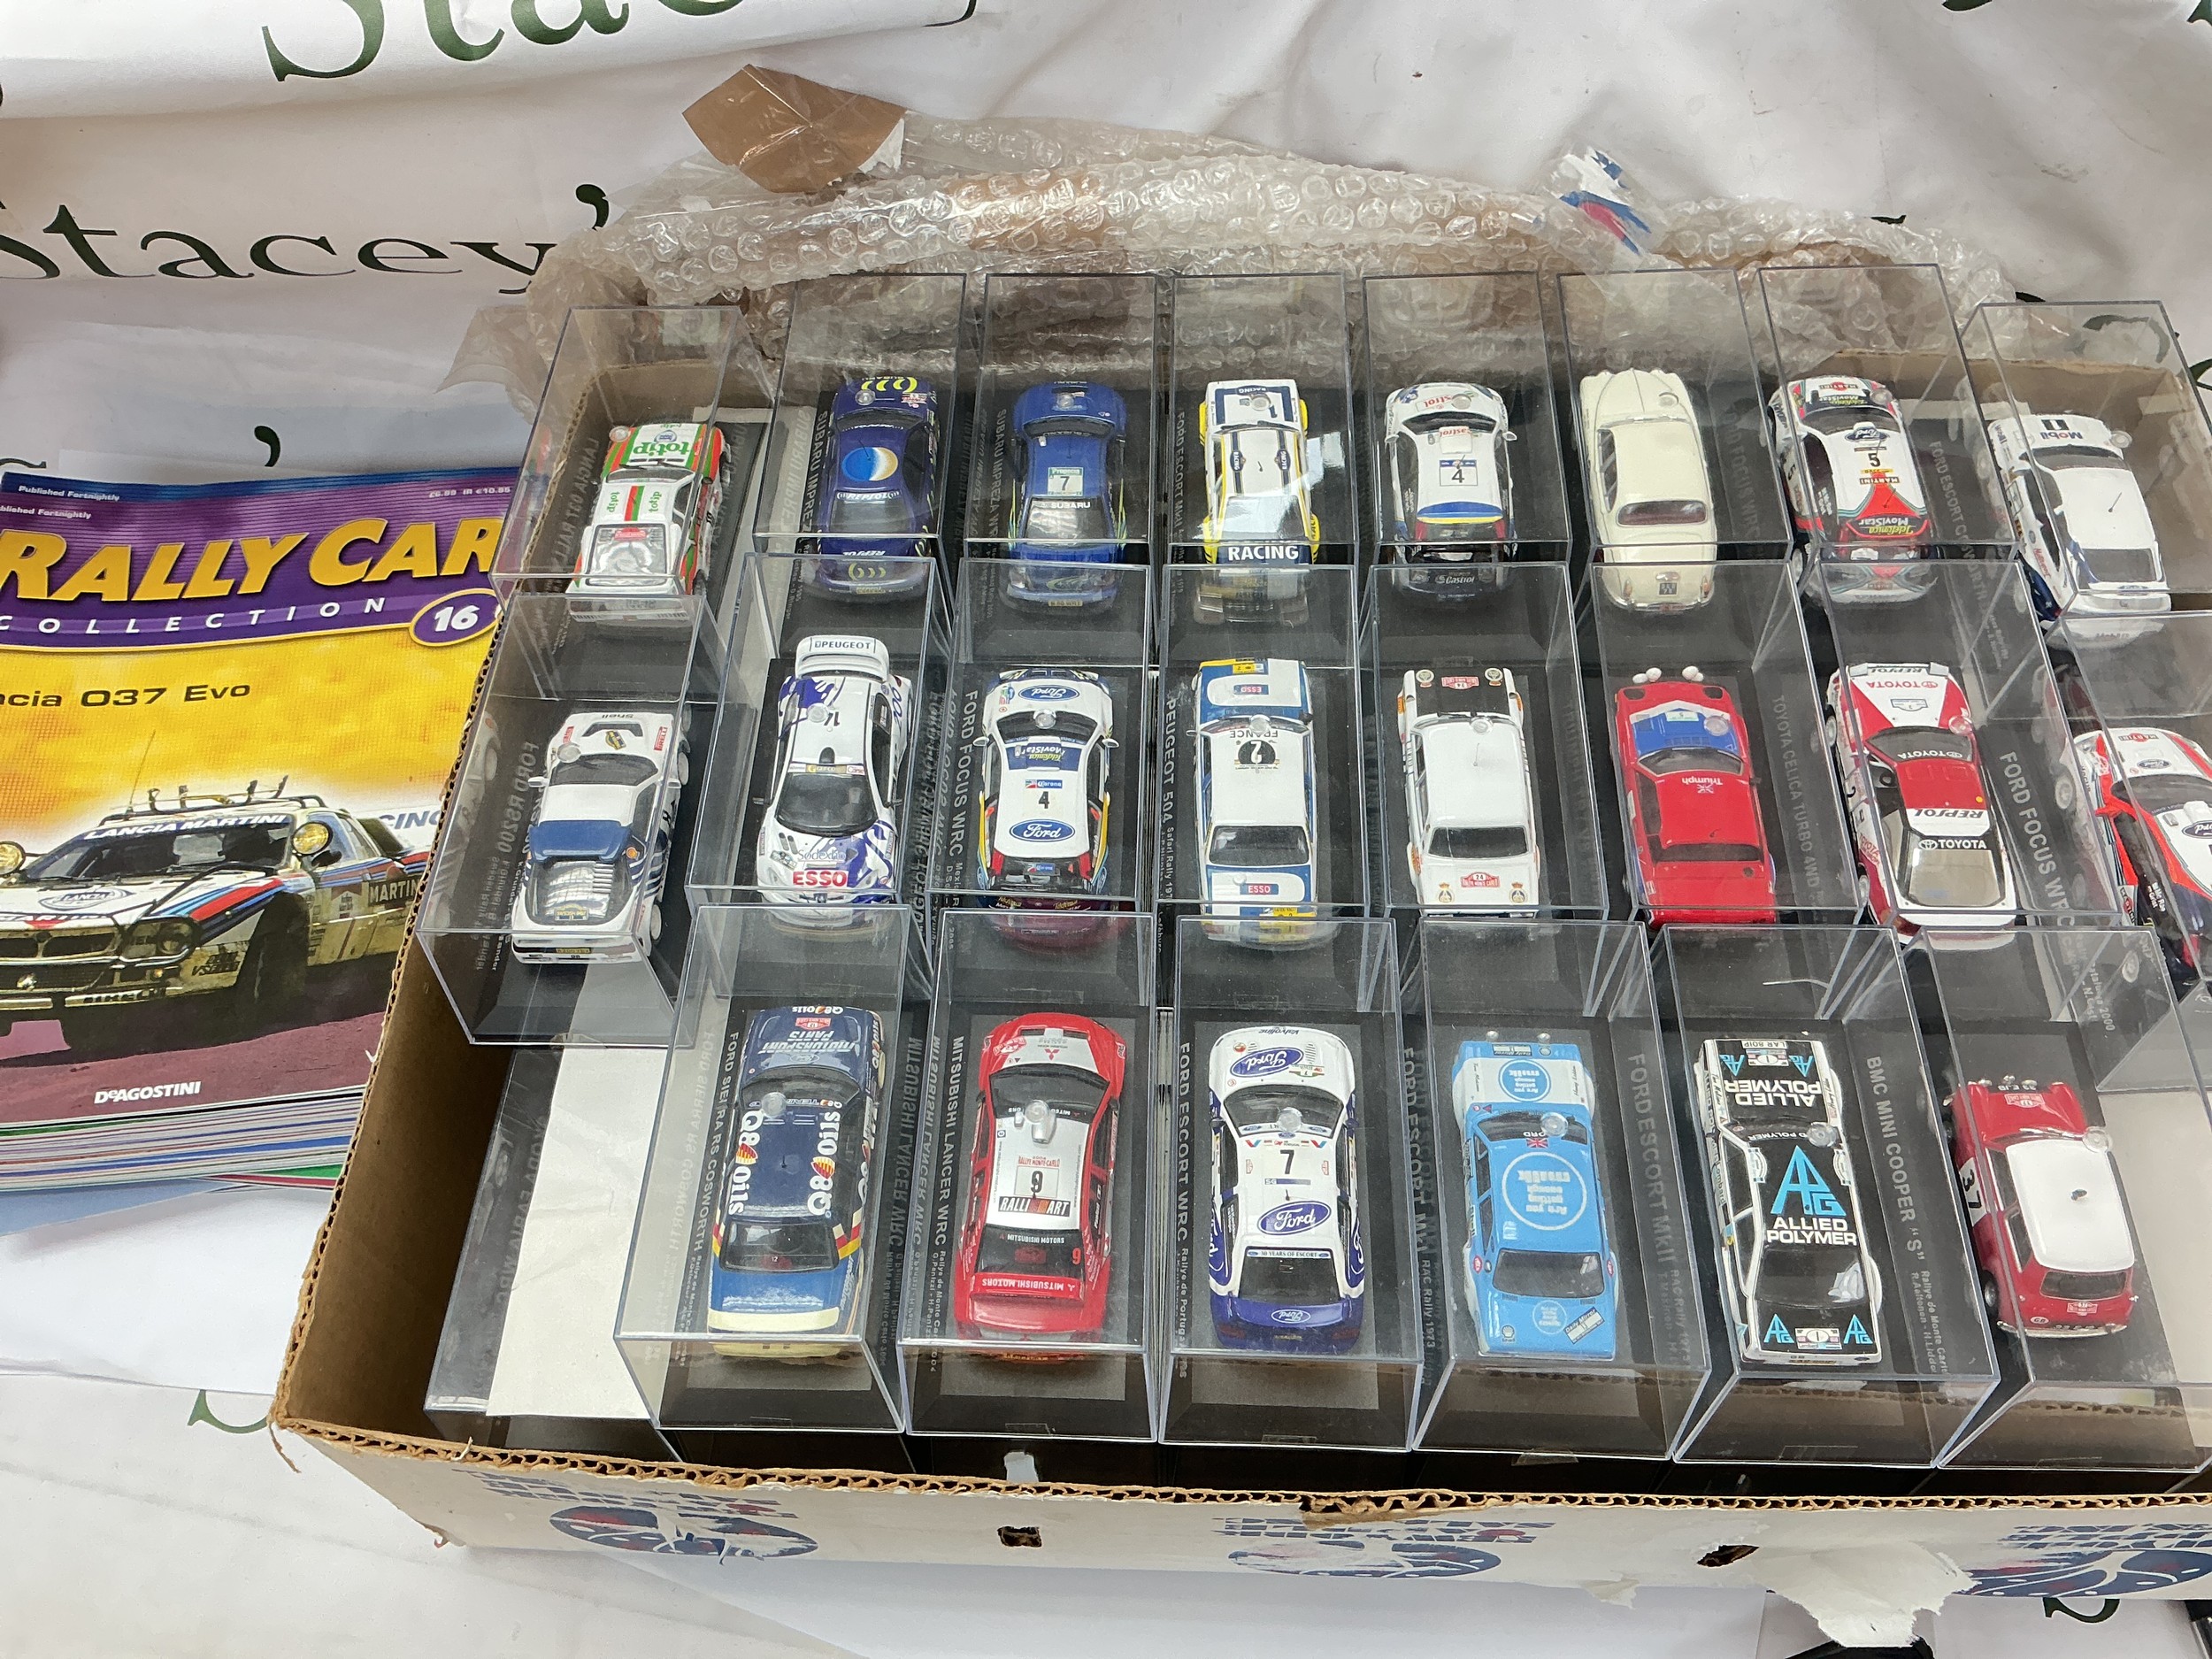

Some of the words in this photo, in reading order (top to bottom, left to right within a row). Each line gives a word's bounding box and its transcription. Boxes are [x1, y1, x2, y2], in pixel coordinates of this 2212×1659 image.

[0, 183, 611, 295] tacey'
[1238, 386, 1267, 395] RACING
[993, 409, 1006, 457] SUBARU
[1175, 412, 1185, 447] FORD
[2049, 419, 2062, 430] 1
[633, 442, 689, 456] totip
[809, 411, 828, 472] SUBARU
[1868, 453, 1881, 467] 5
[1930, 441, 1950, 474] FORD
[1059, 475, 1070, 491] 7
[1174, 447, 1184, 497] ESCORT
[1450, 468, 1465, 483] 4
[18, 484, 65, 497] Published
[67, 490, 120, 502] Fortnightly
[989, 459, 1003, 513] IMPREZA
[1050, 501, 1091, 510] SUBARU
[1937, 474, 1962, 524] ESCORT
[0, 504, 35, 515] blished
[38, 508, 91, 520] Fortnightly
[1858, 517, 1909, 526] MoviStar
[0, 528, 310, 602] RALLY
[309, 518, 502, 586] CAR
[1227, 545, 1299, 561] RACING
[0, 597, 386, 634] COLLECTION
[434, 604, 480, 633] 16
[821, 640, 872, 650] PEUGEOT
[81, 686, 166, 706] 037
[185, 682, 251, 702] Evo
[1031, 686, 1067, 699] Ford
[960, 690, 979, 740] FORD
[1772, 694, 1792, 749] TOYOTA
[656, 726, 668, 751] PIRELLI
[1164, 700, 1176, 786] PEUGEOT
[1229, 729, 1279, 738] FRANCE
[2118, 733, 2158, 741] MARTINI
[1021, 746, 1064, 755] MoviStar
[1250, 741, 1263, 764] 2
[1897, 749, 1947, 758] TOYOTA
[954, 744, 973, 808] FOCUS
[1681, 775, 1723, 786] Triumph
[1784, 750, 1805, 801] CELICA
[1038, 790, 1050, 810] 4
[1162, 791, 1173, 824] 504
[1913, 809, 1983, 818] REPSOL
[85, 823, 177, 841] LANCIA
[181, 813, 289, 832] MARTINI
[948, 811, 966, 857] WRC
[1022, 823, 1062, 839] Ford
[1791, 803, 1815, 853] TURBO
[1999, 751, 2031, 803] FORD
[2017, 807, 2056, 874] FOCUS
[2041, 876, 2076, 926] WRC
[1165, 827, 1175, 853] Safari
[1937, 839, 1986, 849] TOYOTA
[793, 871, 848, 886] ESSO
[1164, 856, 1174, 879] Rally
[1802, 855, 1820, 887] 4WD
[1248, 885, 1271, 894] ESSO
[2120, 887, 2136, 924] MARTINI
[792, 1005, 816, 1014] Oils
[824, 1005, 843, 1015] Q8
[761, 1041, 854, 1053] MOTORSPORT
[787, 1030, 834, 1041] PARTS
[723, 1032, 739, 1071] FORD
[872, 1050, 880, 1070] Q8
[1245, 1050, 1287, 1072] Ford
[944, 1035, 964, 1129] MITSUBISHI
[1179, 1043, 1192, 1097] FORD
[1866, 1056, 1887, 1095] BMC
[1626, 1053, 1651, 1115] FORD
[1723, 1079, 1822, 1094] POLYMER
[713, 1076, 733, 1132] SIERRA
[1734, 1092, 1816, 1108] ALLIED
[740, 1110, 764, 1145] Q8
[1875, 1099, 1898, 1139] MINI
[708, 1133, 723, 1156] RS
[816, 1111, 841, 1156] Oils
[1176, 1102, 1190, 1184] ESCORT
[1747, 1132, 1796, 1141] POLYMER
[938, 1132, 955, 1202] LANCER
[1279, 1150, 1294, 1174] 7
[1636, 1117, 1669, 1210] ESCORT
[1030, 1170, 1043, 1194] 9
[1517, 1170, 1571, 1183] milk
[1886, 1142, 1916, 1222] COOPER
[727, 1166, 751, 1217] Oils
[808, 1175, 833, 1217] Q8
[1527, 1193, 1563, 1204] getting
[1962, 1168, 1983, 1210] 37
[692, 1158, 720, 1252] COSWORTH
[1175, 1190, 1189, 1241] WRC
[1525, 1203, 1544, 1214] you
[1548, 1205, 1568, 1216] Are
[934, 1204, 949, 1247] WRC
[1275, 1210, 1316, 1231] Ford
[1772, 1217, 1848, 1232] ALLIED
[1007, 1233, 1040, 1243] MITSUBISHI
[1041, 1234, 1064, 1244] MOTORS
[1766, 1230, 1858, 1246] POLYMER
[938, 1250, 947, 1276] Rallye
[1071, 1247, 1081, 1265] 9
[1179, 1248, 1189, 1280] Rallye
[981, 1278, 1016, 1288] MOTORS
[1421, 1259, 1432, 1284] RAC
[937, 1279, 944, 1289] de
[1017, 1279, 1064, 1290] MITSUBISHI
[1180, 1283, 1188, 1294] de
[1920, 1270, 1932, 1300] Rallye
[933, 1291, 944, 1315] Monte
[1422, 1288, 1434, 1317] Rally
[1926, 1301, 1936, 1313] de
[1279, 1310, 1303, 1320] Ford
[1579, 1309, 1597, 1324] Mirror
[1424, 1321, 1436, 1348] 1973
[1930, 1315, 1944, 1345] Monte
